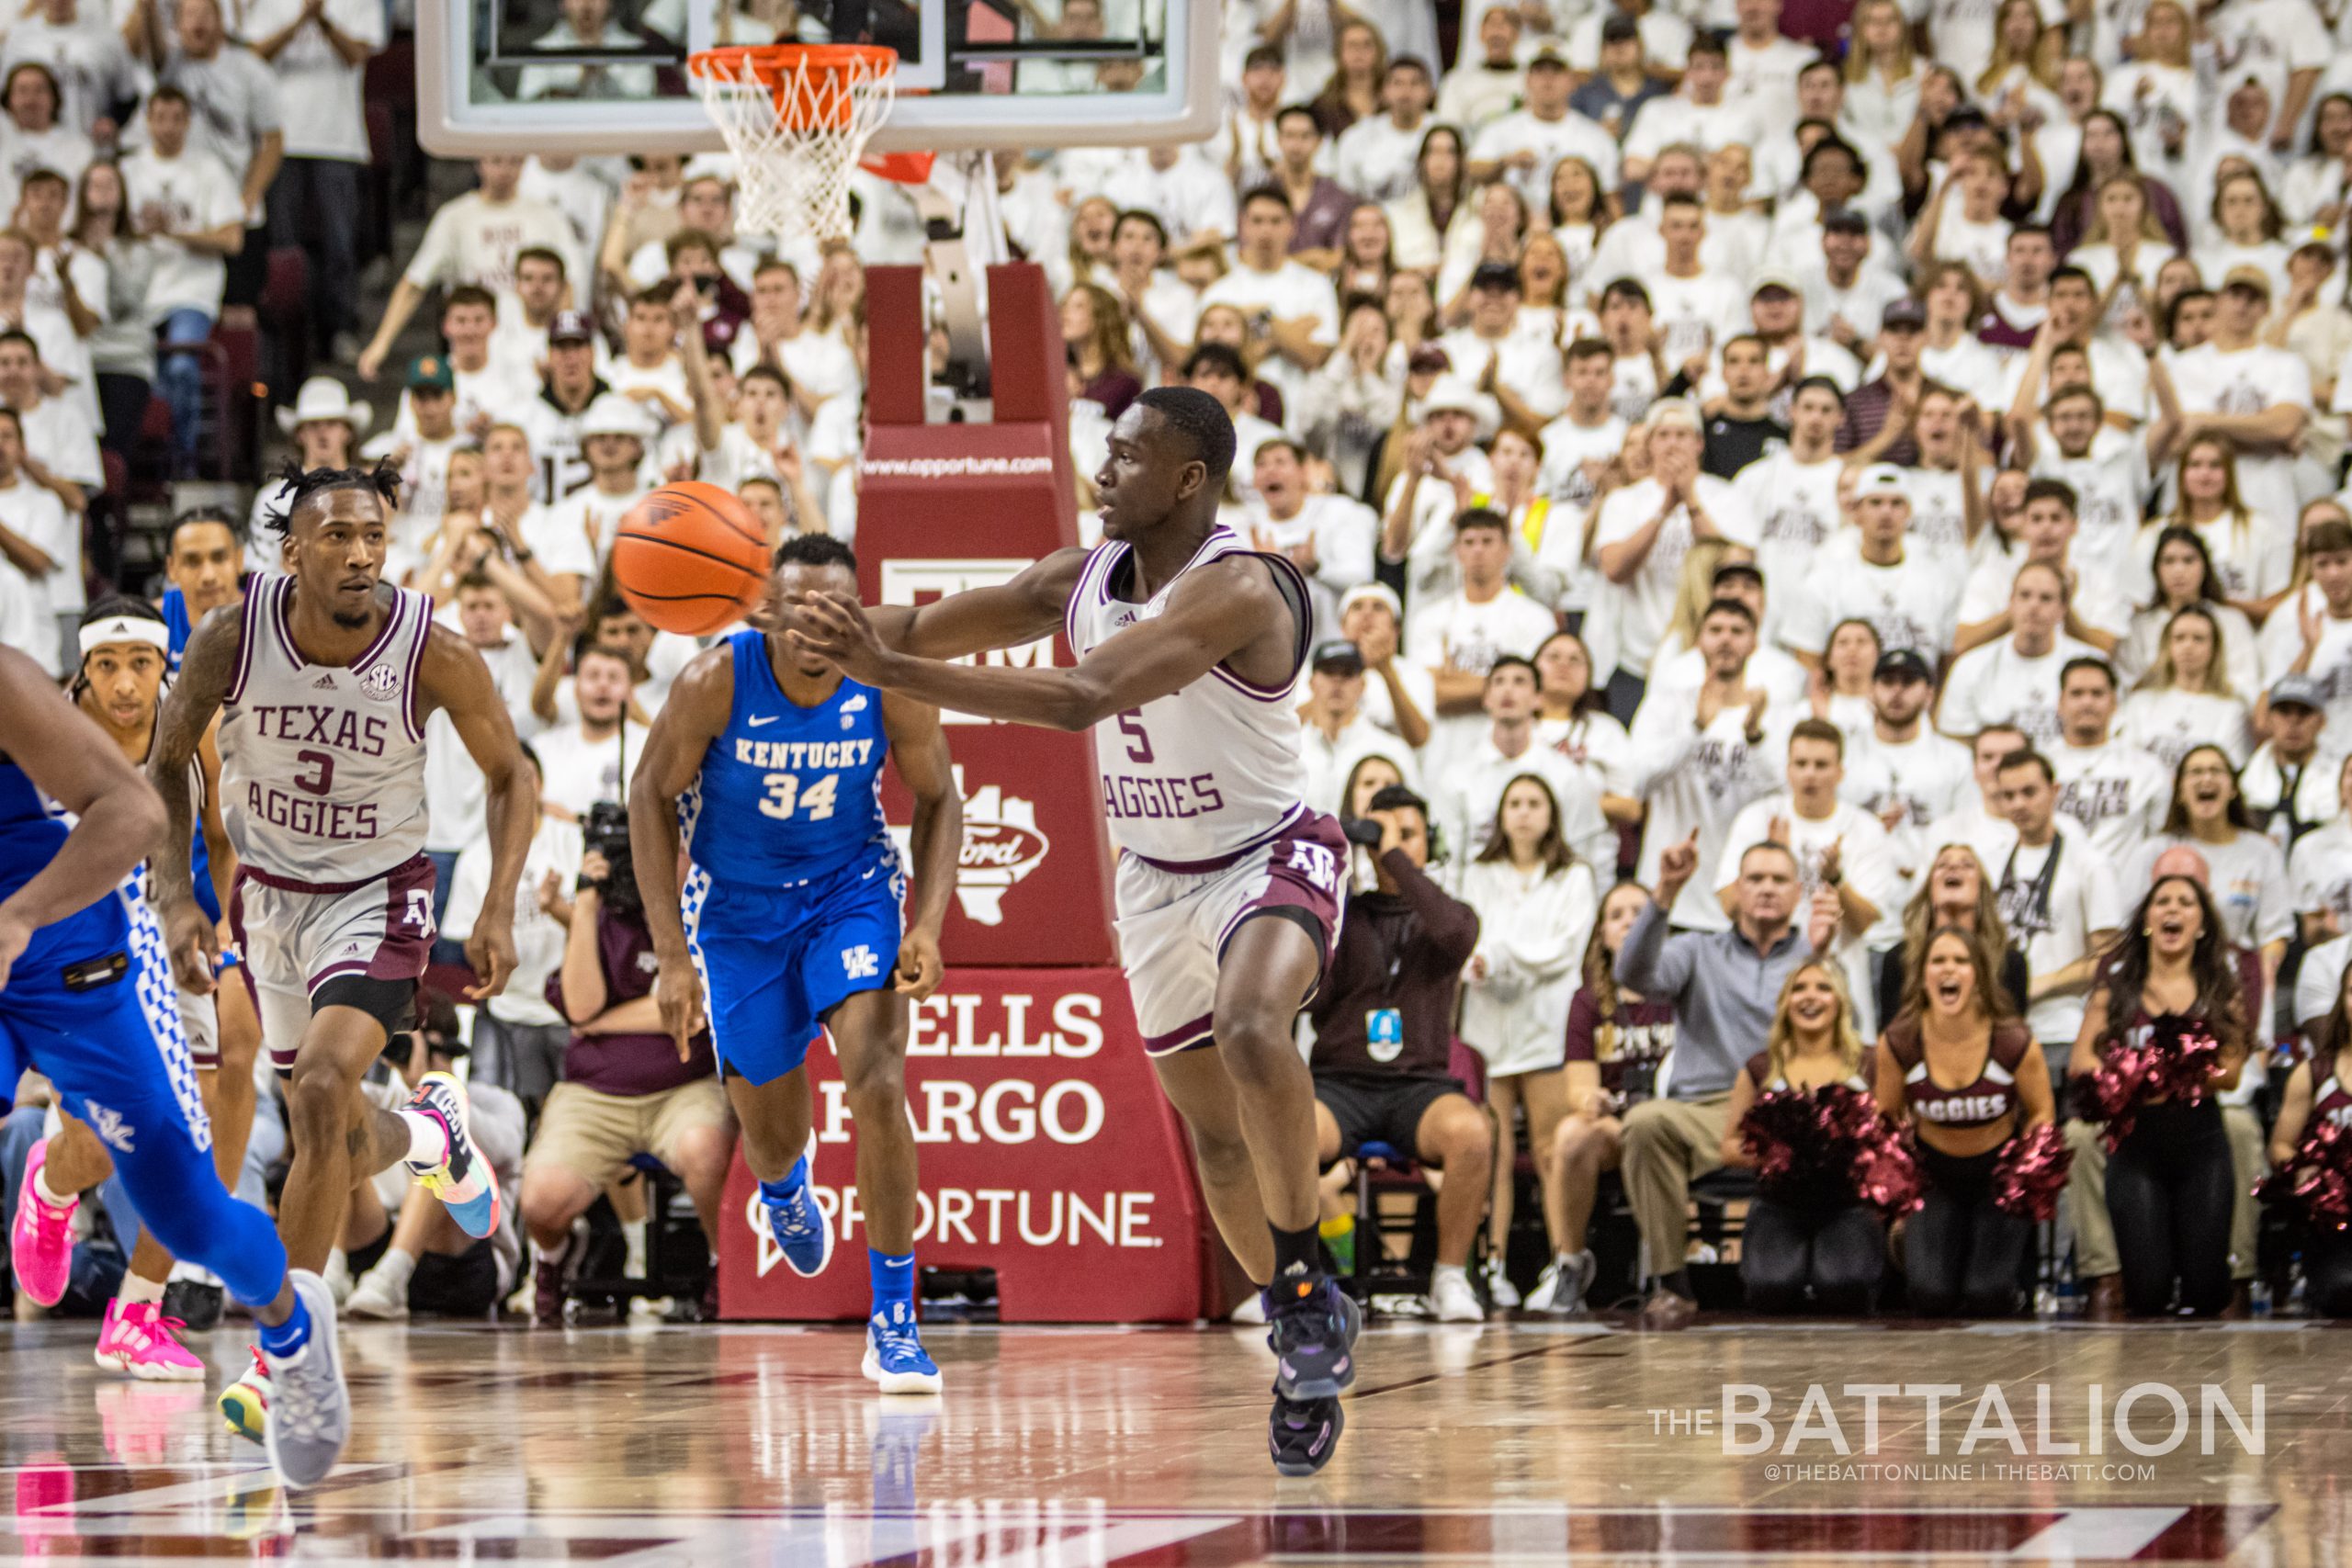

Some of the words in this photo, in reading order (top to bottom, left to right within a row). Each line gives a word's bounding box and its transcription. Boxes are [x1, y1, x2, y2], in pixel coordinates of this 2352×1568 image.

[369, 664, 396, 691] SEC
[253, 705, 387, 757] TEXAS
[736, 738, 874, 770] KENTUCKY
[1117, 706, 1155, 763] 5
[294, 750, 334, 795] 3
[1102, 773, 1225, 818] AGGIES
[248, 780, 379, 840] AGGIES
[758, 773, 840, 822] 34
[824, 994, 1104, 1058] ELLS
